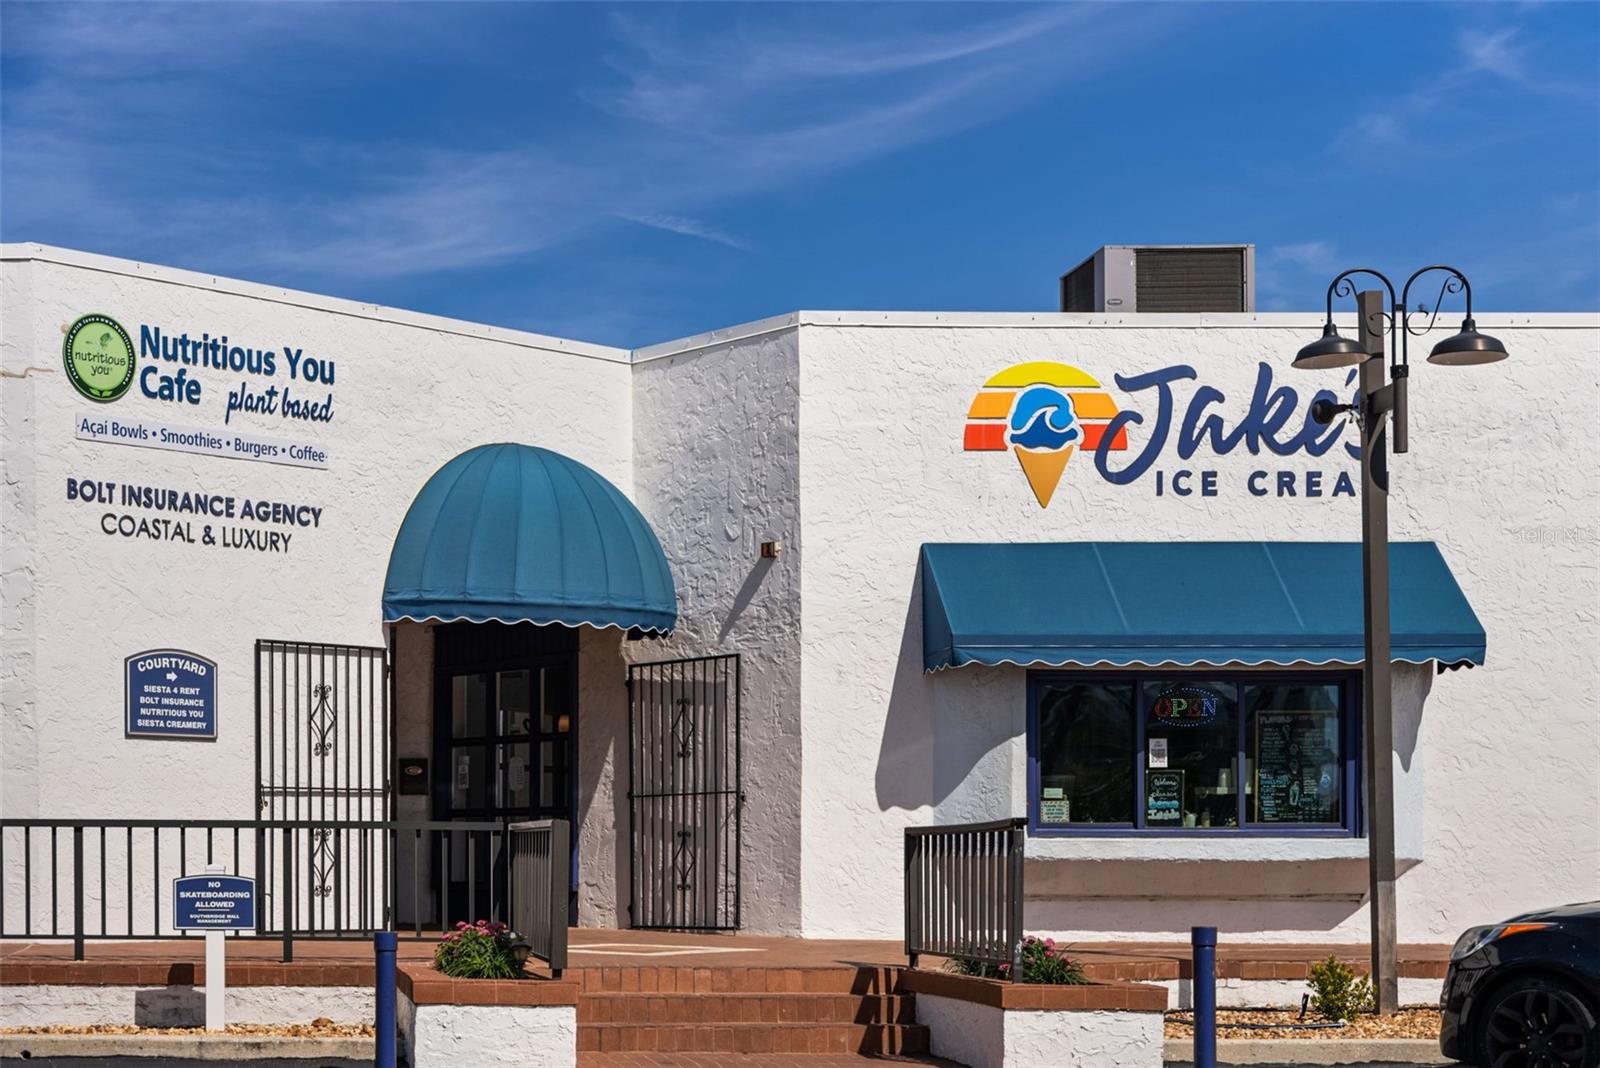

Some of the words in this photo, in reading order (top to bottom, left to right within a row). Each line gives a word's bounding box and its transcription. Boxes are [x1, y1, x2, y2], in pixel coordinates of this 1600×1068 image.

[75, 351, 126, 367] nutritious
[140, 324, 277, 377] Nutritious
[284, 347, 336, 385] You
[91, 365, 110, 377] you
[139, 365, 201, 405] Cafe
[225, 382, 279, 424] plant
[281, 387, 335, 423] based
[112, 422, 148, 440] Bowls
[160, 428, 223, 450] Smoothies
[234, 438, 278, 458] Burgers
[289, 445, 326, 463] Coffee
[1156, 470, 1218, 497] ICE
[1247, 470, 1357, 497] CREA
[67, 477, 116, 504] BOLT
[121, 484, 235, 518] INSURANCE
[240, 499, 322, 528] AGENCY
[101, 512, 195, 544] COASTAL
[202, 525, 216, 545] &
[222, 526, 292, 553] LUXURY
[137, 657, 207, 676] COURTYARD
[144, 685, 171, 694] SIESTA
[172, 686, 178, 694] 4
[180, 687, 200, 695] RENT
[140, 696, 160, 705] BOLT
[161, 697, 205, 707] INSURANCE
[1153, 698, 1218, 717] OPEN
[140, 708, 187, 718] NUTRITIOUS
[188, 710, 204, 718] YOU
[137, 719, 165, 728] SIESTA
[166, 720, 207, 729] CREAMERY
